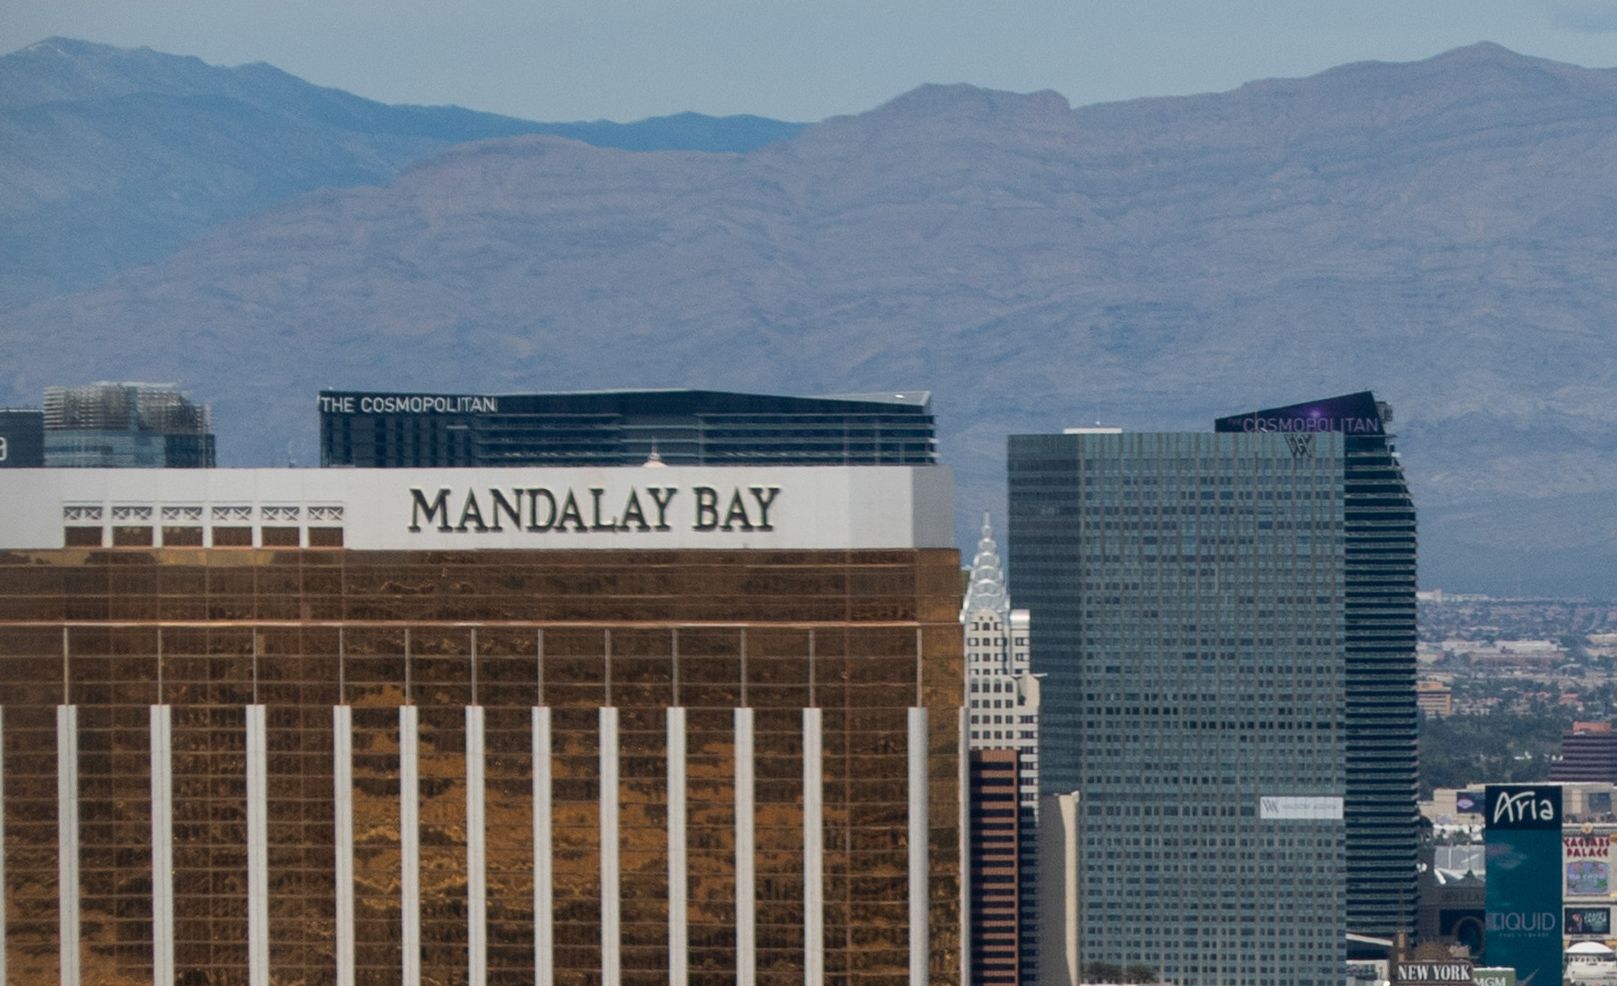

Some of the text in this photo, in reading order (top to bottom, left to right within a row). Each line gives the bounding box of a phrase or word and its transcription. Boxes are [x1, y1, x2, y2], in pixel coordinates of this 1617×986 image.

[320, 396, 497, 413] THE COSMOPOLITAN
[1243, 416, 1379, 432] COSMOPOLITAN
[408, 486, 781, 533] MANDALAY BAY
[1493, 791, 1555, 824] Aria
[1566, 847, 1609, 858] PALACE
[1397, 964, 1472, 981] NEW YORK
